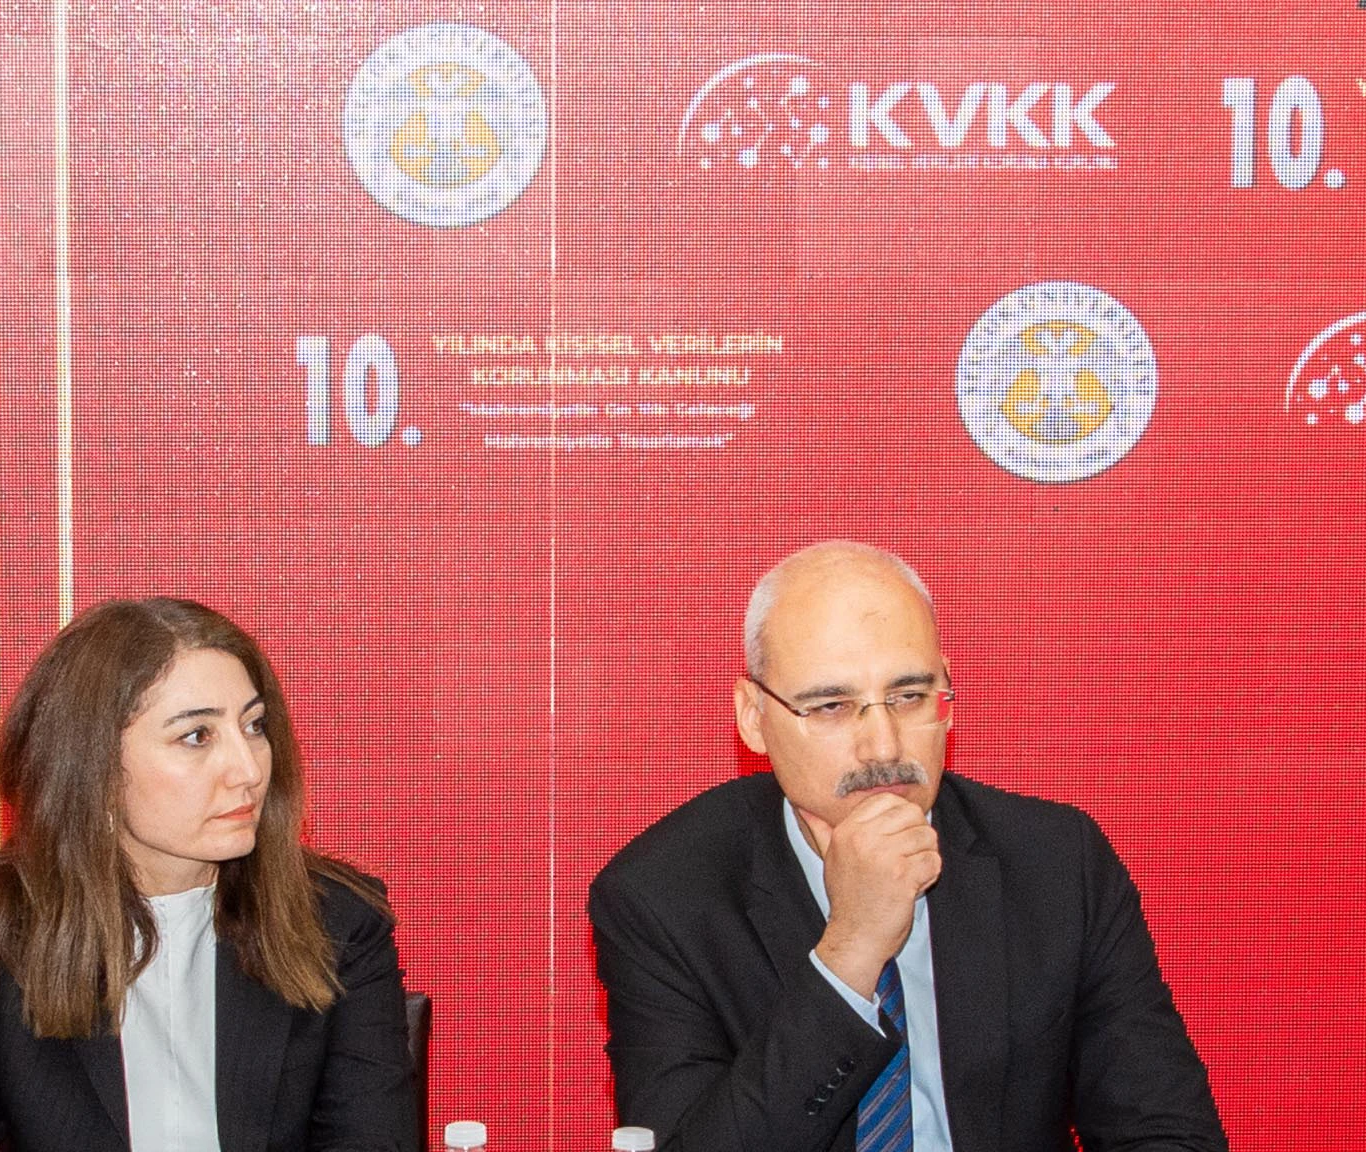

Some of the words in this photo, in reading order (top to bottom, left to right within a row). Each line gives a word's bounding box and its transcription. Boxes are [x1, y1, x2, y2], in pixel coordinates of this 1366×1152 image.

[850, 83, 1114, 147] KVKK
[1222, 76, 1343, 188] 10.
[296, 333, 420, 446] 10.
